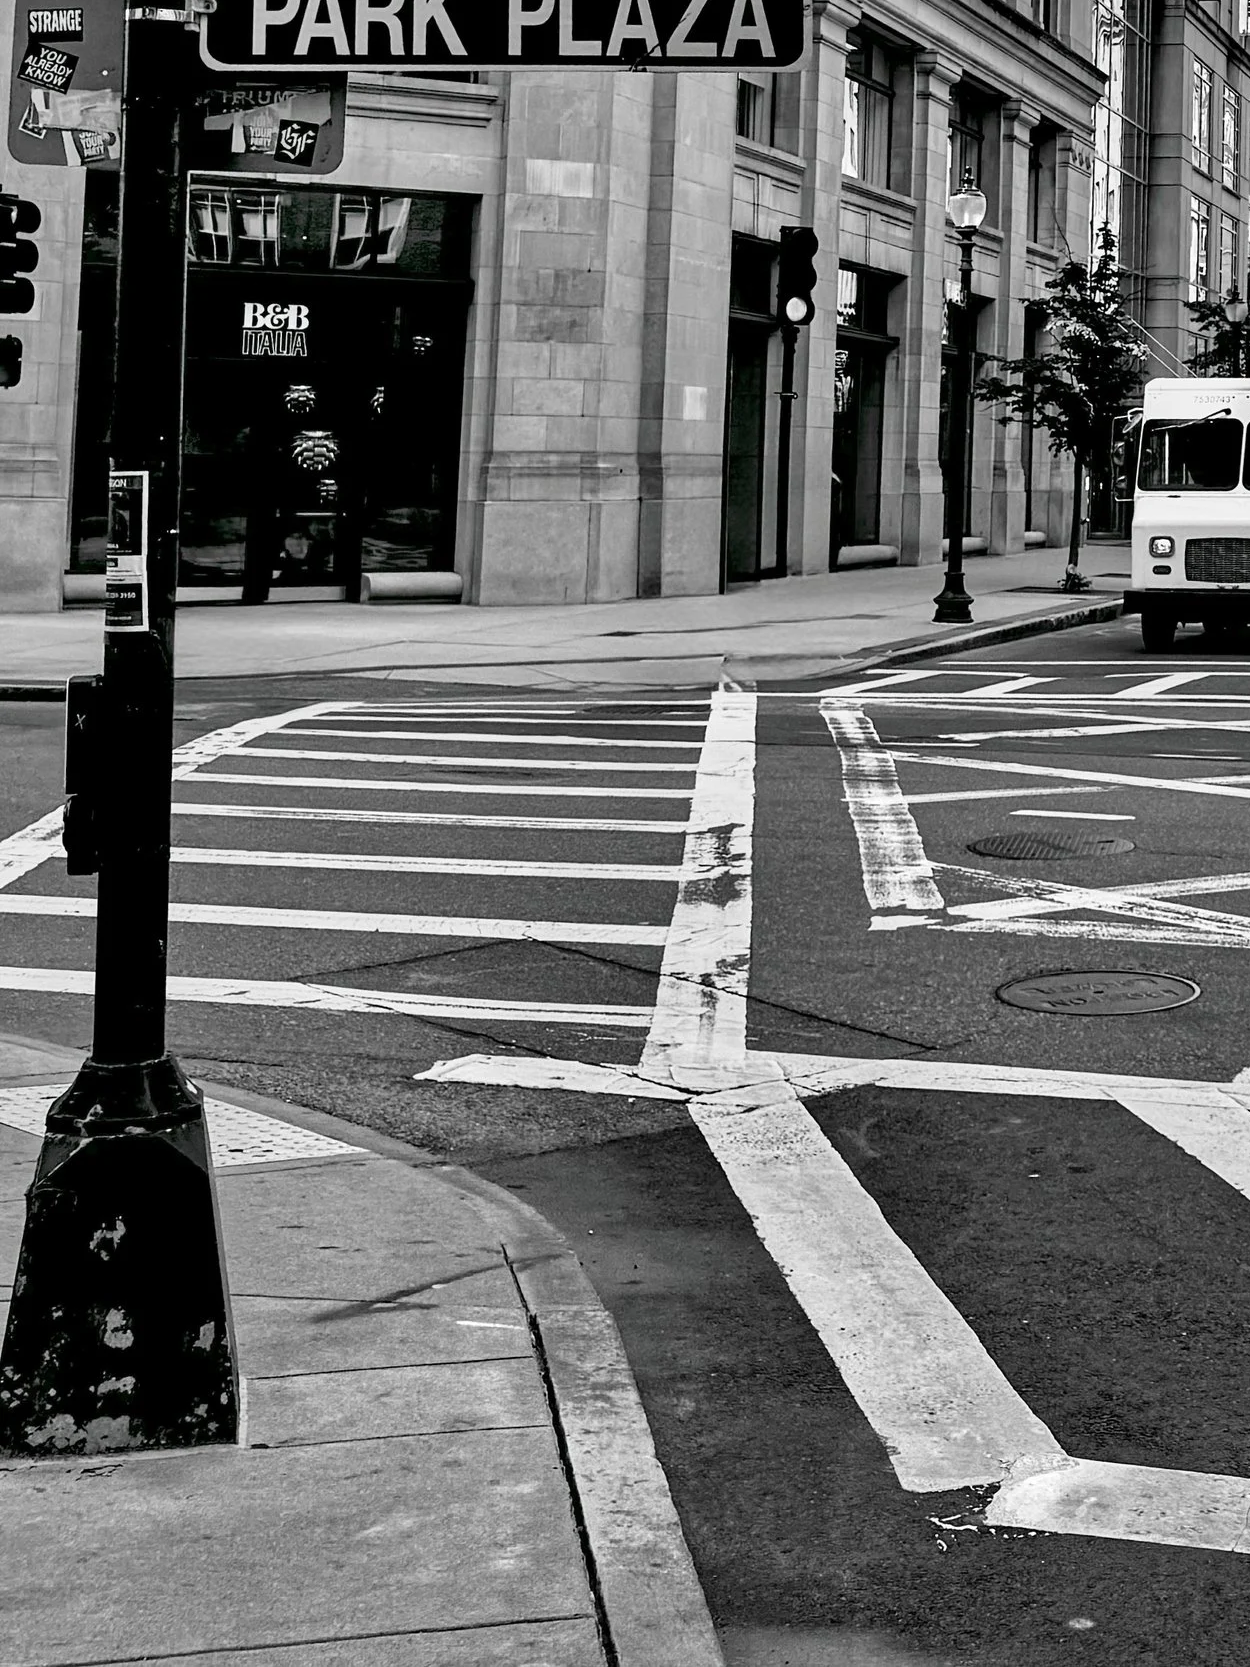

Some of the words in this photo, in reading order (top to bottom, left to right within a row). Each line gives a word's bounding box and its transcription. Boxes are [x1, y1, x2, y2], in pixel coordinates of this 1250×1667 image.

[29, 9, 82, 33] STRANGE
[24, 54, 73, 77] ALREADY
[40, 47, 67, 64] YOU
[25, 66, 66, 86] KNOW
[242, 302, 310, 330] B&B
[242, 330, 308, 357] ITALIA
